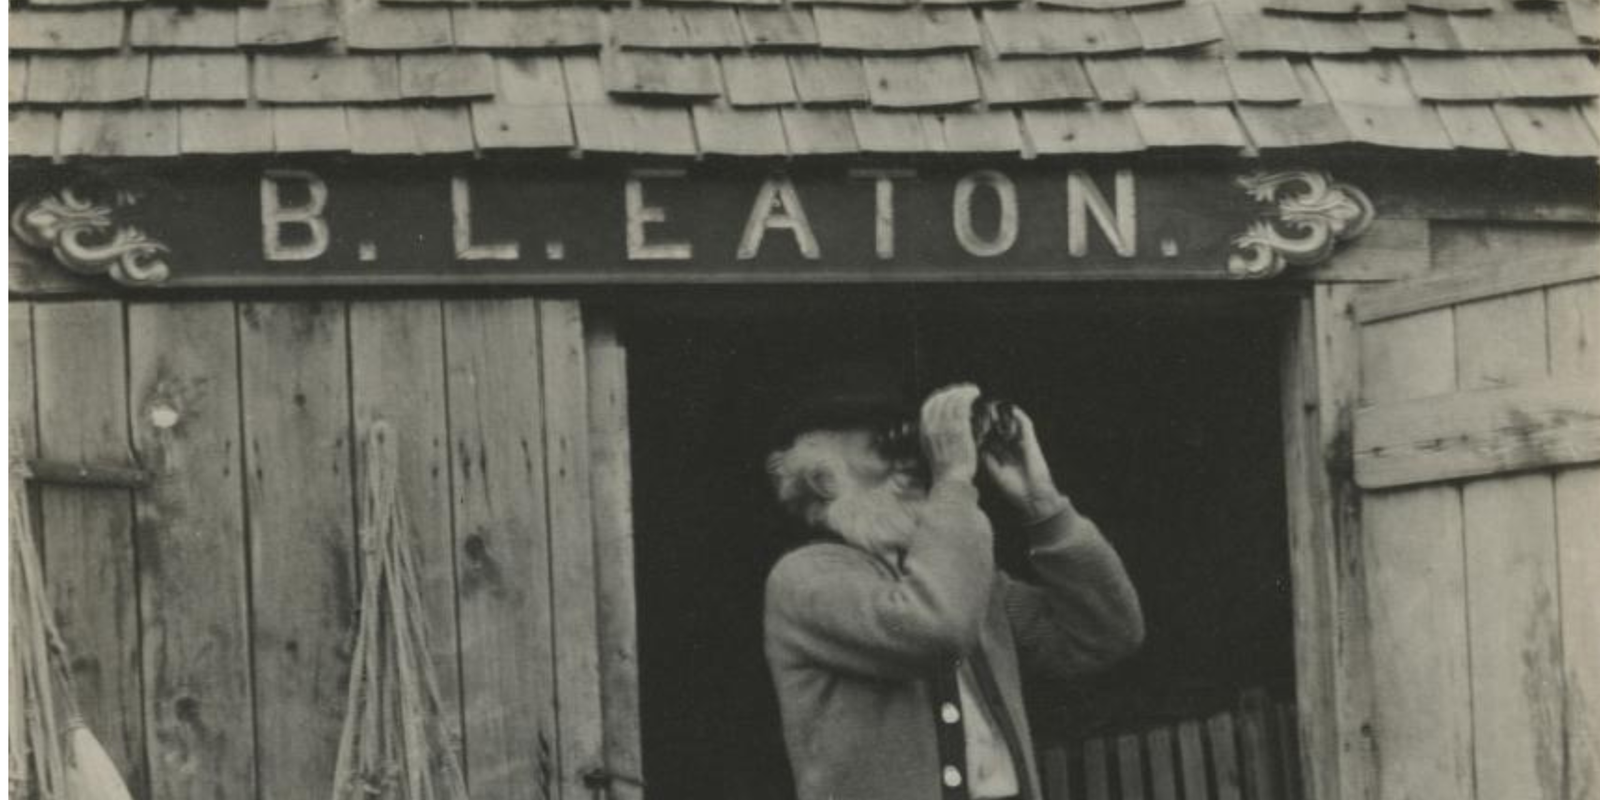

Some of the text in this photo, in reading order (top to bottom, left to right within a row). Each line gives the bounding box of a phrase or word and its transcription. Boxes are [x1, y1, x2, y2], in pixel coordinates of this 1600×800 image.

[260, 169, 1178, 260] B. L. EATON.
